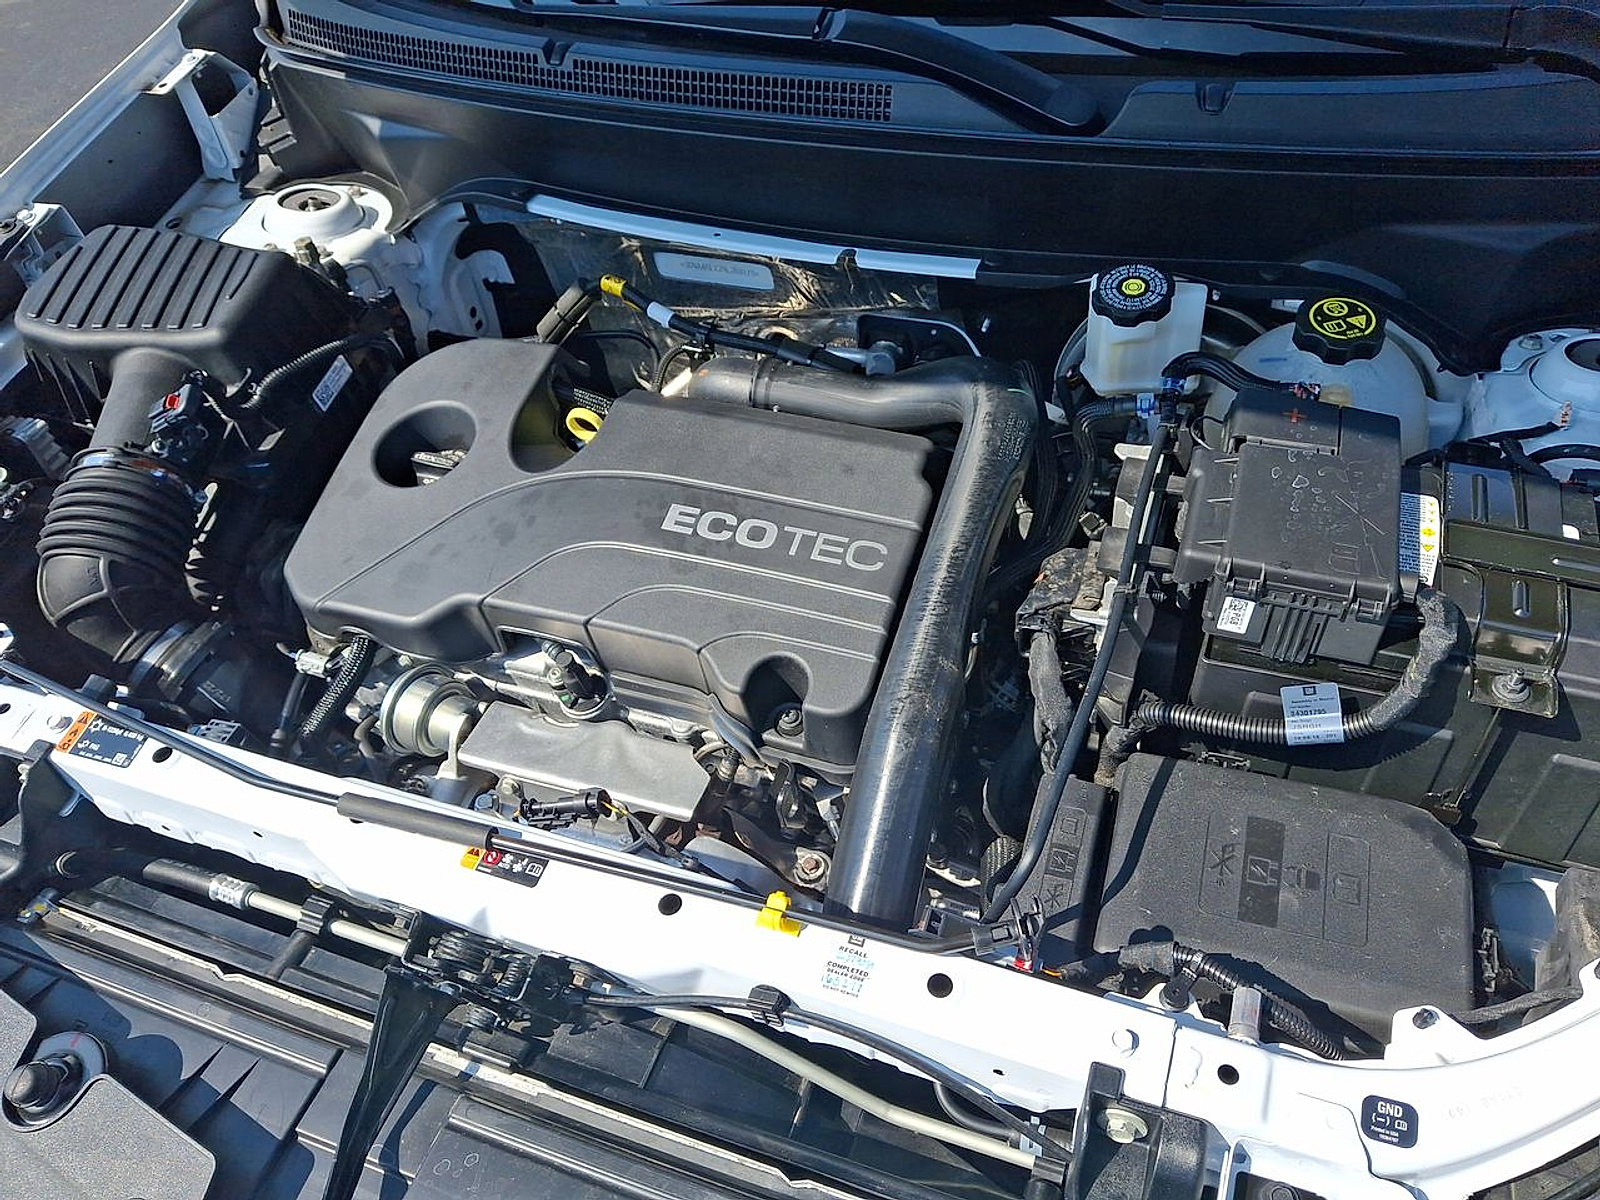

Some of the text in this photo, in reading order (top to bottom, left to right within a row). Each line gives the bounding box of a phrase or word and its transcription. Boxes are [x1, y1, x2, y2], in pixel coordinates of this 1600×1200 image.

[660, 503, 888, 571] ECOTEC
[839, 946, 868, 958] RECALL
[827, 961, 869, 977] COMPLETED
[1377, 1101, 1403, 1118] GND
